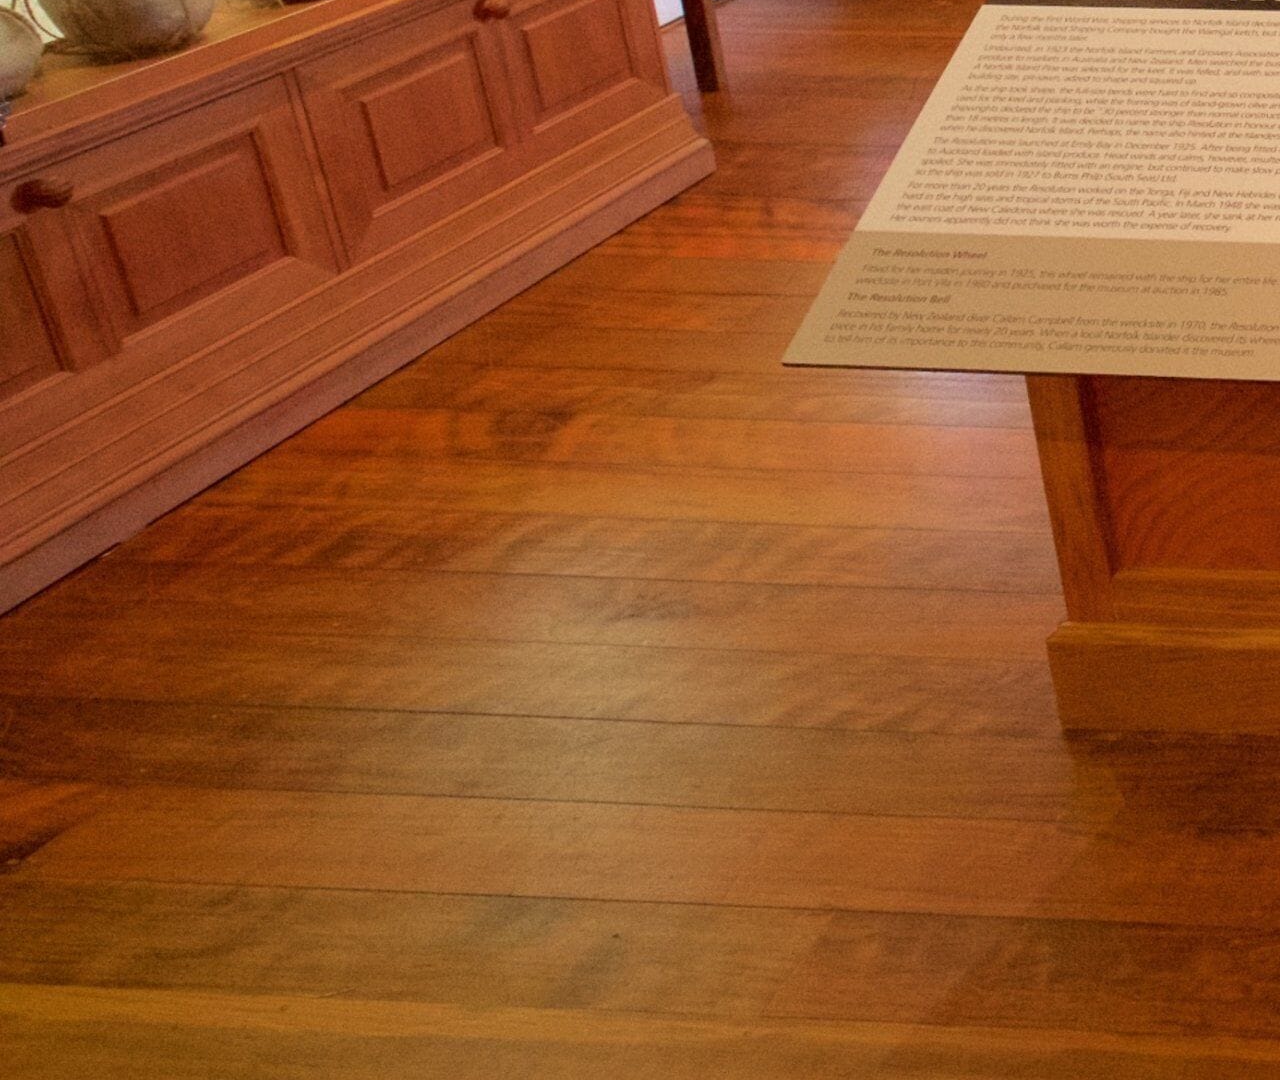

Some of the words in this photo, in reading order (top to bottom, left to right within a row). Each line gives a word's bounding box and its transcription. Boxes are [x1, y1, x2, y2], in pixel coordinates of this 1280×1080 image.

[871, 247, 892, 255] The
[893, 247, 951, 257] Resolution
[952, 249, 989, 258] Wheel
[846, 291, 868, 300] The
[869, 292, 929, 302] Resolution
[930, 294, 952, 303] Bell
